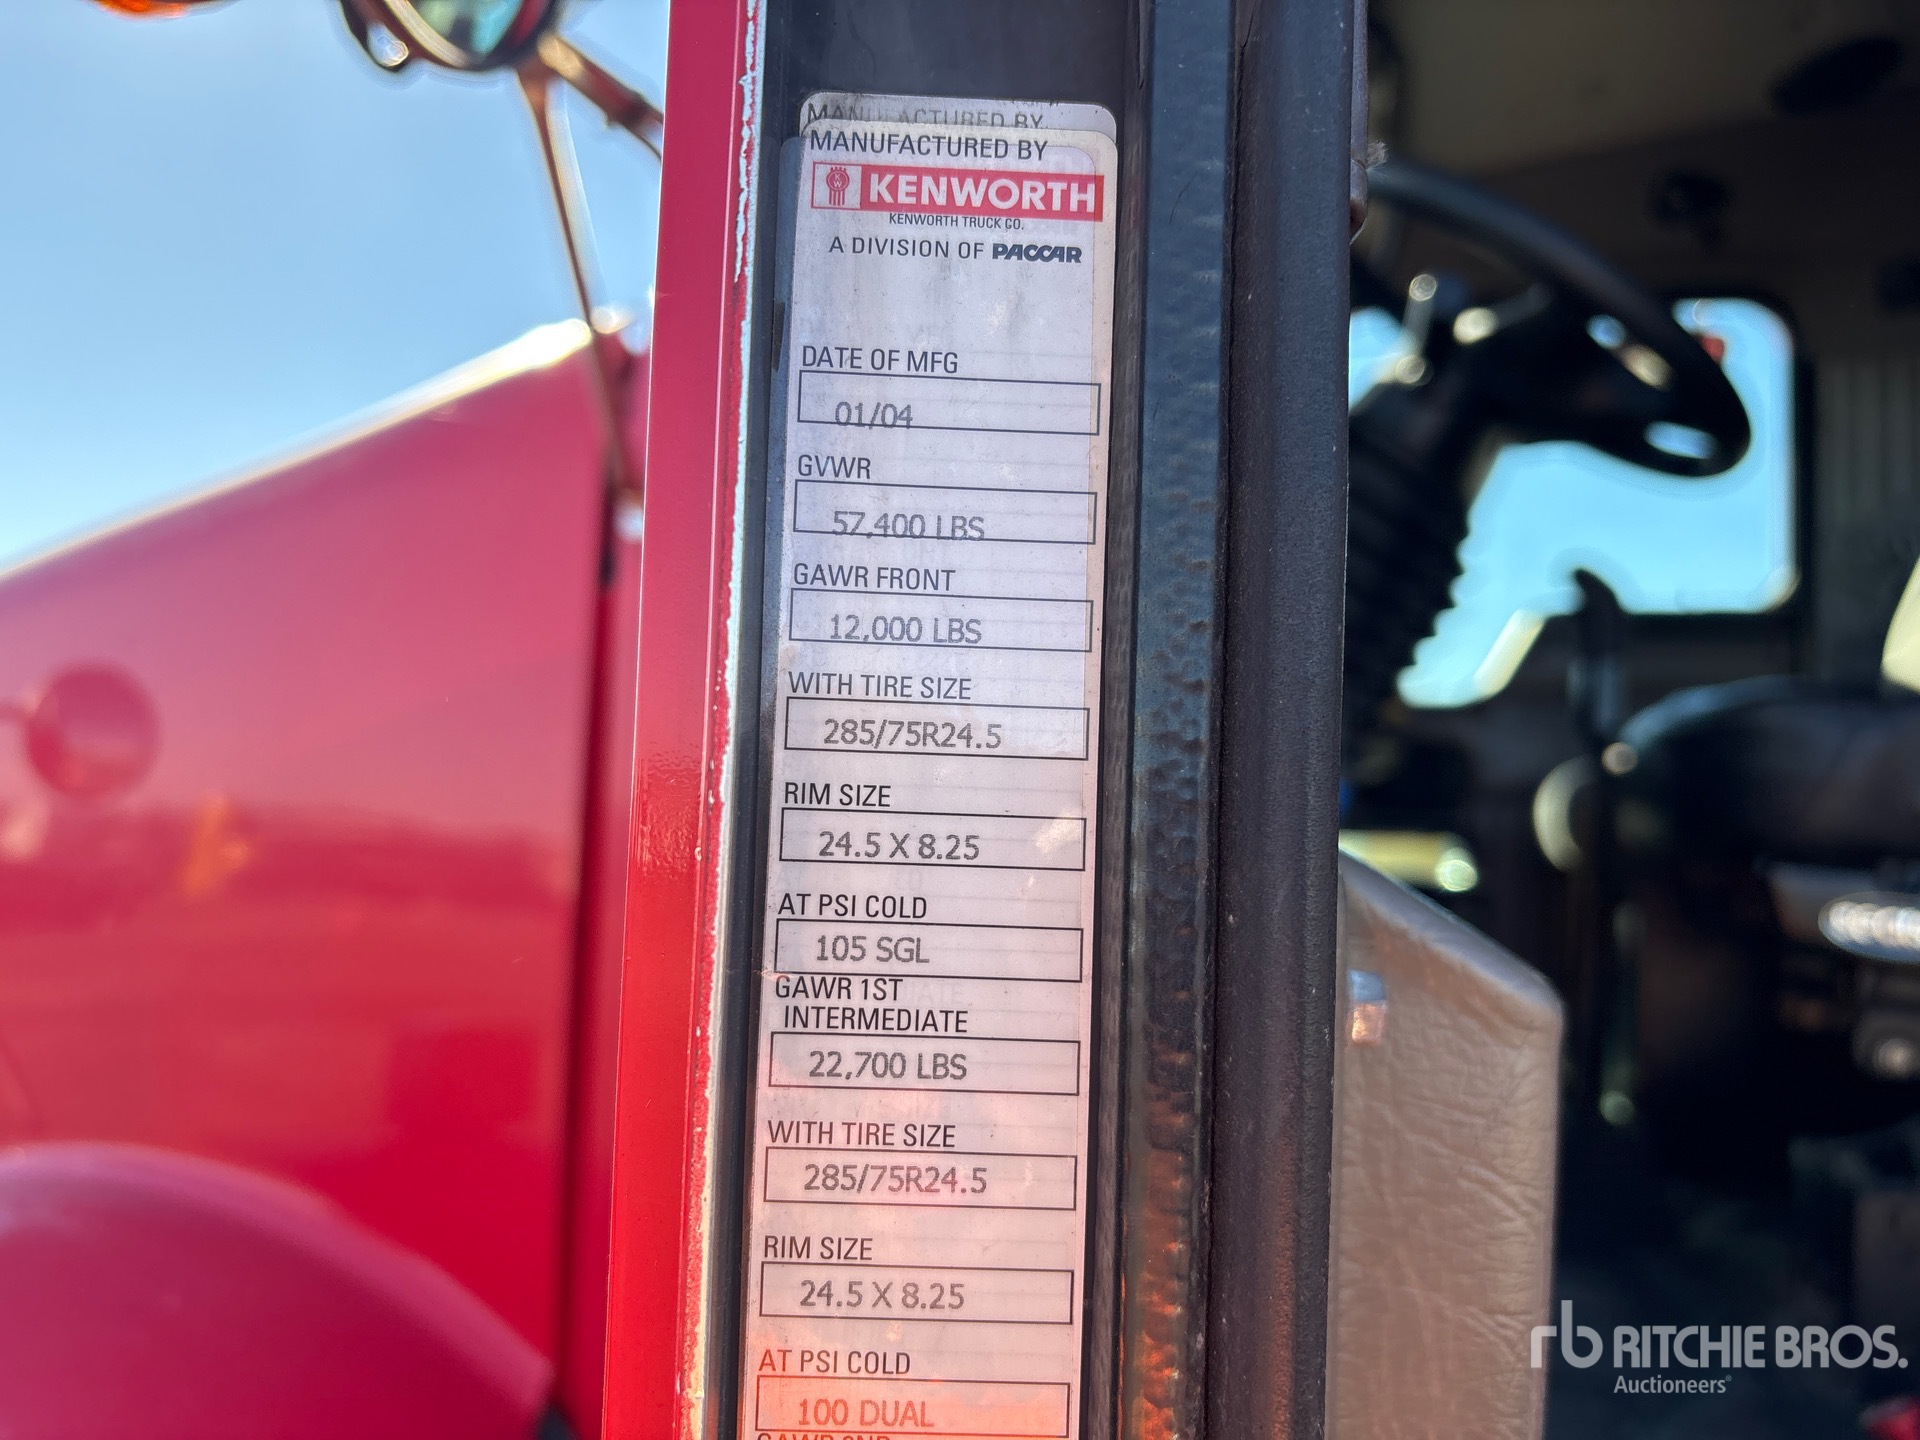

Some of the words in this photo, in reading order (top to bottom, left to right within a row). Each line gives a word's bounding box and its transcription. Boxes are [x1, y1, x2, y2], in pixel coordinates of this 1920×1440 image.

[810, 130, 1009, 160] MANUFACTURED
[1017, 140, 1048, 161] BY
[869, 173, 1096, 212] KENWORTH
[889, 213, 958, 227] KENWORTH
[962, 216, 1001, 229] TRUCK
[828, 237, 844, 253] A
[852, 237, 949, 258] DIVISION
[958, 242, 984, 260] OF
[992, 244, 1082, 263] PACCAR
[802, 345, 863, 369] DATE
[870, 349, 900, 371] OF
[908, 350, 958, 373] MFG
[835, 401, 913, 429] 01/04
[798, 454, 871, 479] GVWR
[832, 511, 925, 539] 57,400
[936, 515, 985, 541] LBS
[794, 563, 868, 587] GAWR
[877, 567, 956, 591] FRONT
[830, 614, 923, 643] 12,000
[933, 617, 982, 644] LBS
[788, 671, 853, 696] WITH
[861, 674, 913, 697] TIRE
[921, 677, 971, 699] SIZE
[823, 718, 1002, 749] 285/75R24.5
[784, 782, 830, 805] RIM
[839, 784, 891, 807] SIZE
[819, 831, 881, 858] 24.5
[889, 833, 910, 859] X
[918, 834, 980, 860] 8.25
[778, 894, 811, 915] AT
[819, 895, 856, 917] PSI
[865, 895, 927, 919] COLD
[817, 935, 867, 962] 105
[876, 936, 929, 963] SGL
[776, 975, 852, 999] GAWR
[863, 978, 903, 1001] 1ST
[784, 1005, 968, 1033] INTERMEDIATE
[809, 1050, 906, 1080] 22,700
[918, 1052, 967, 1080] LBS
[768, 1120, 833, 1144] WITH
[842, 1122, 895, 1145] TIRE
[903, 1124, 956, 1147] SIZE
[804, 1163, 987, 1194] 285/75R24.5
[764, 1235, 811, 1259] RIM
[820, 1237, 873, 1260] SIZE
[800, 1280, 863, 1308] 24.5
[872, 1281, 893, 1308] X
[902, 1282, 965, 1310] 8.25
[759, 1349, 793, 1371] AT
[800, 1350, 838, 1373] PSI
[848, 1351, 911, 1375] COLD
[798, 1398, 848, 1426] 100
[860, 1400, 934, 1428] DUAL
